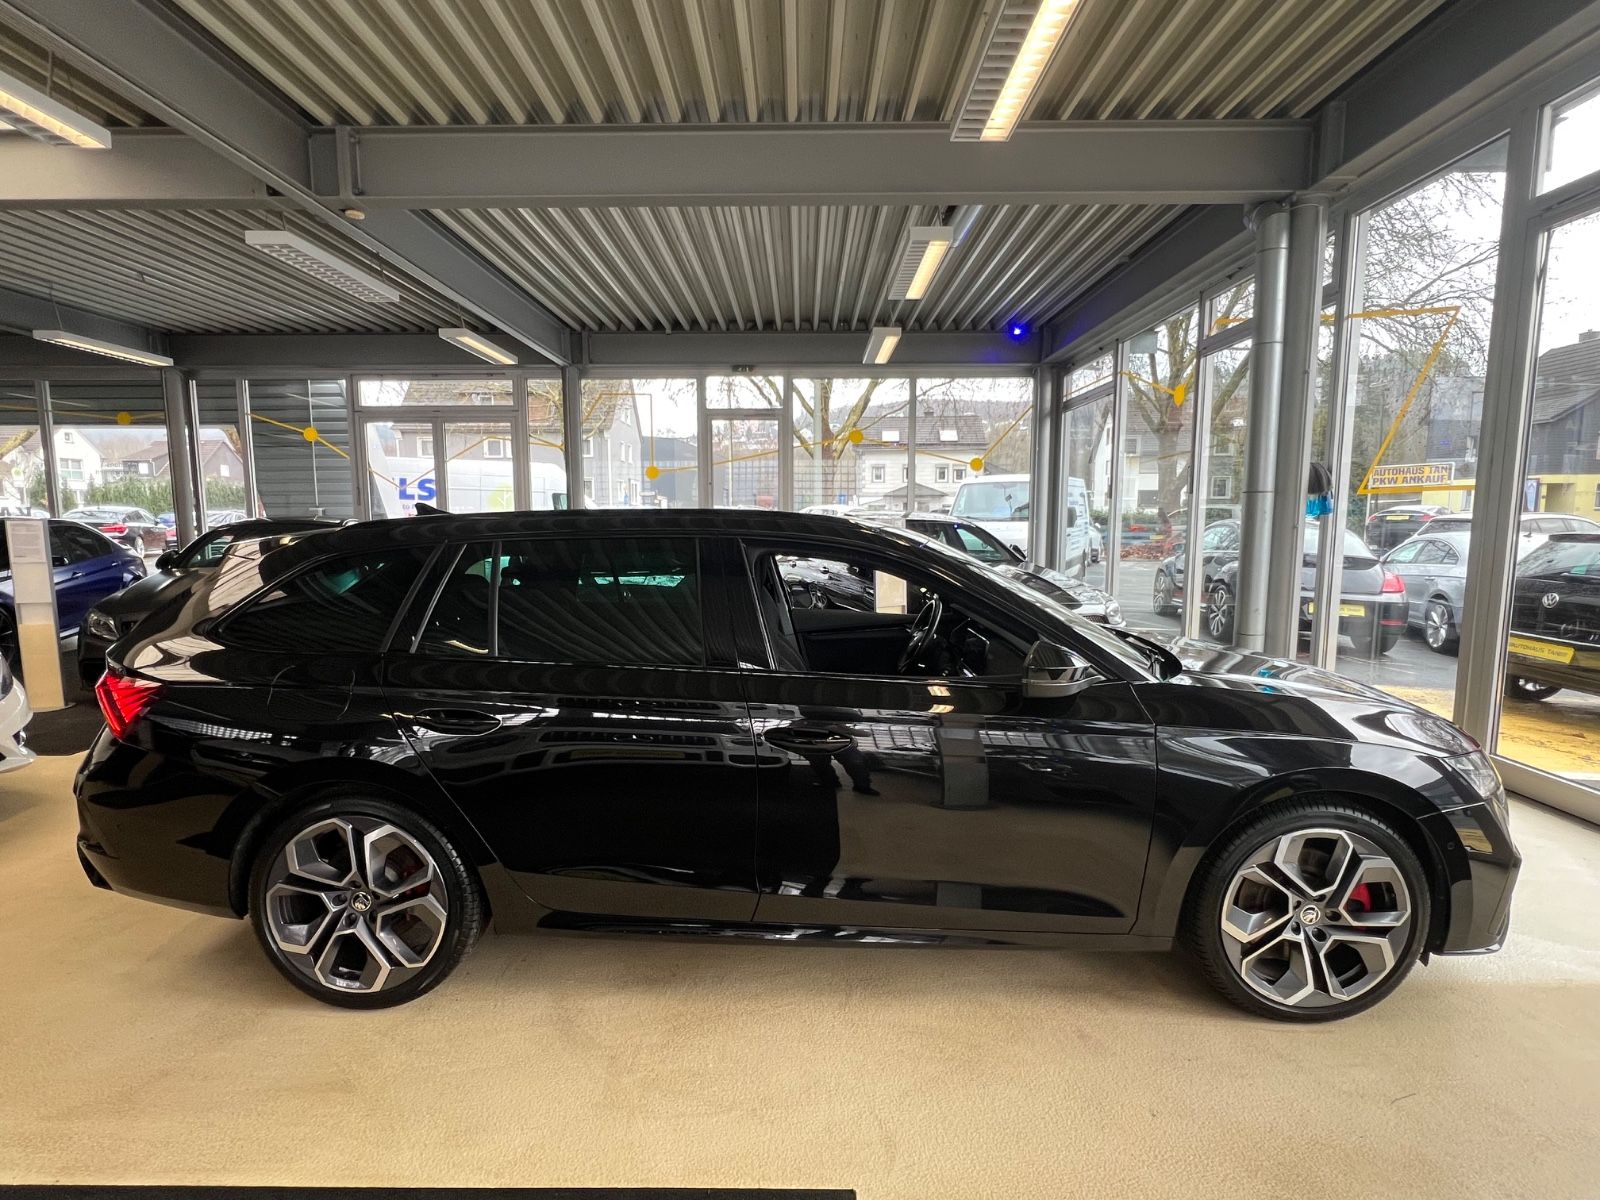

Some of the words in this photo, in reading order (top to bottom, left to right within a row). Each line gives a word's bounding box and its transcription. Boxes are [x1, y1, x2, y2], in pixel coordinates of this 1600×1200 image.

[1373, 465, 1424, 477] AUTOHAUS
[1372, 476, 1398, 486] PKW
[1403, 474, 1448, 485] ANKAUF
